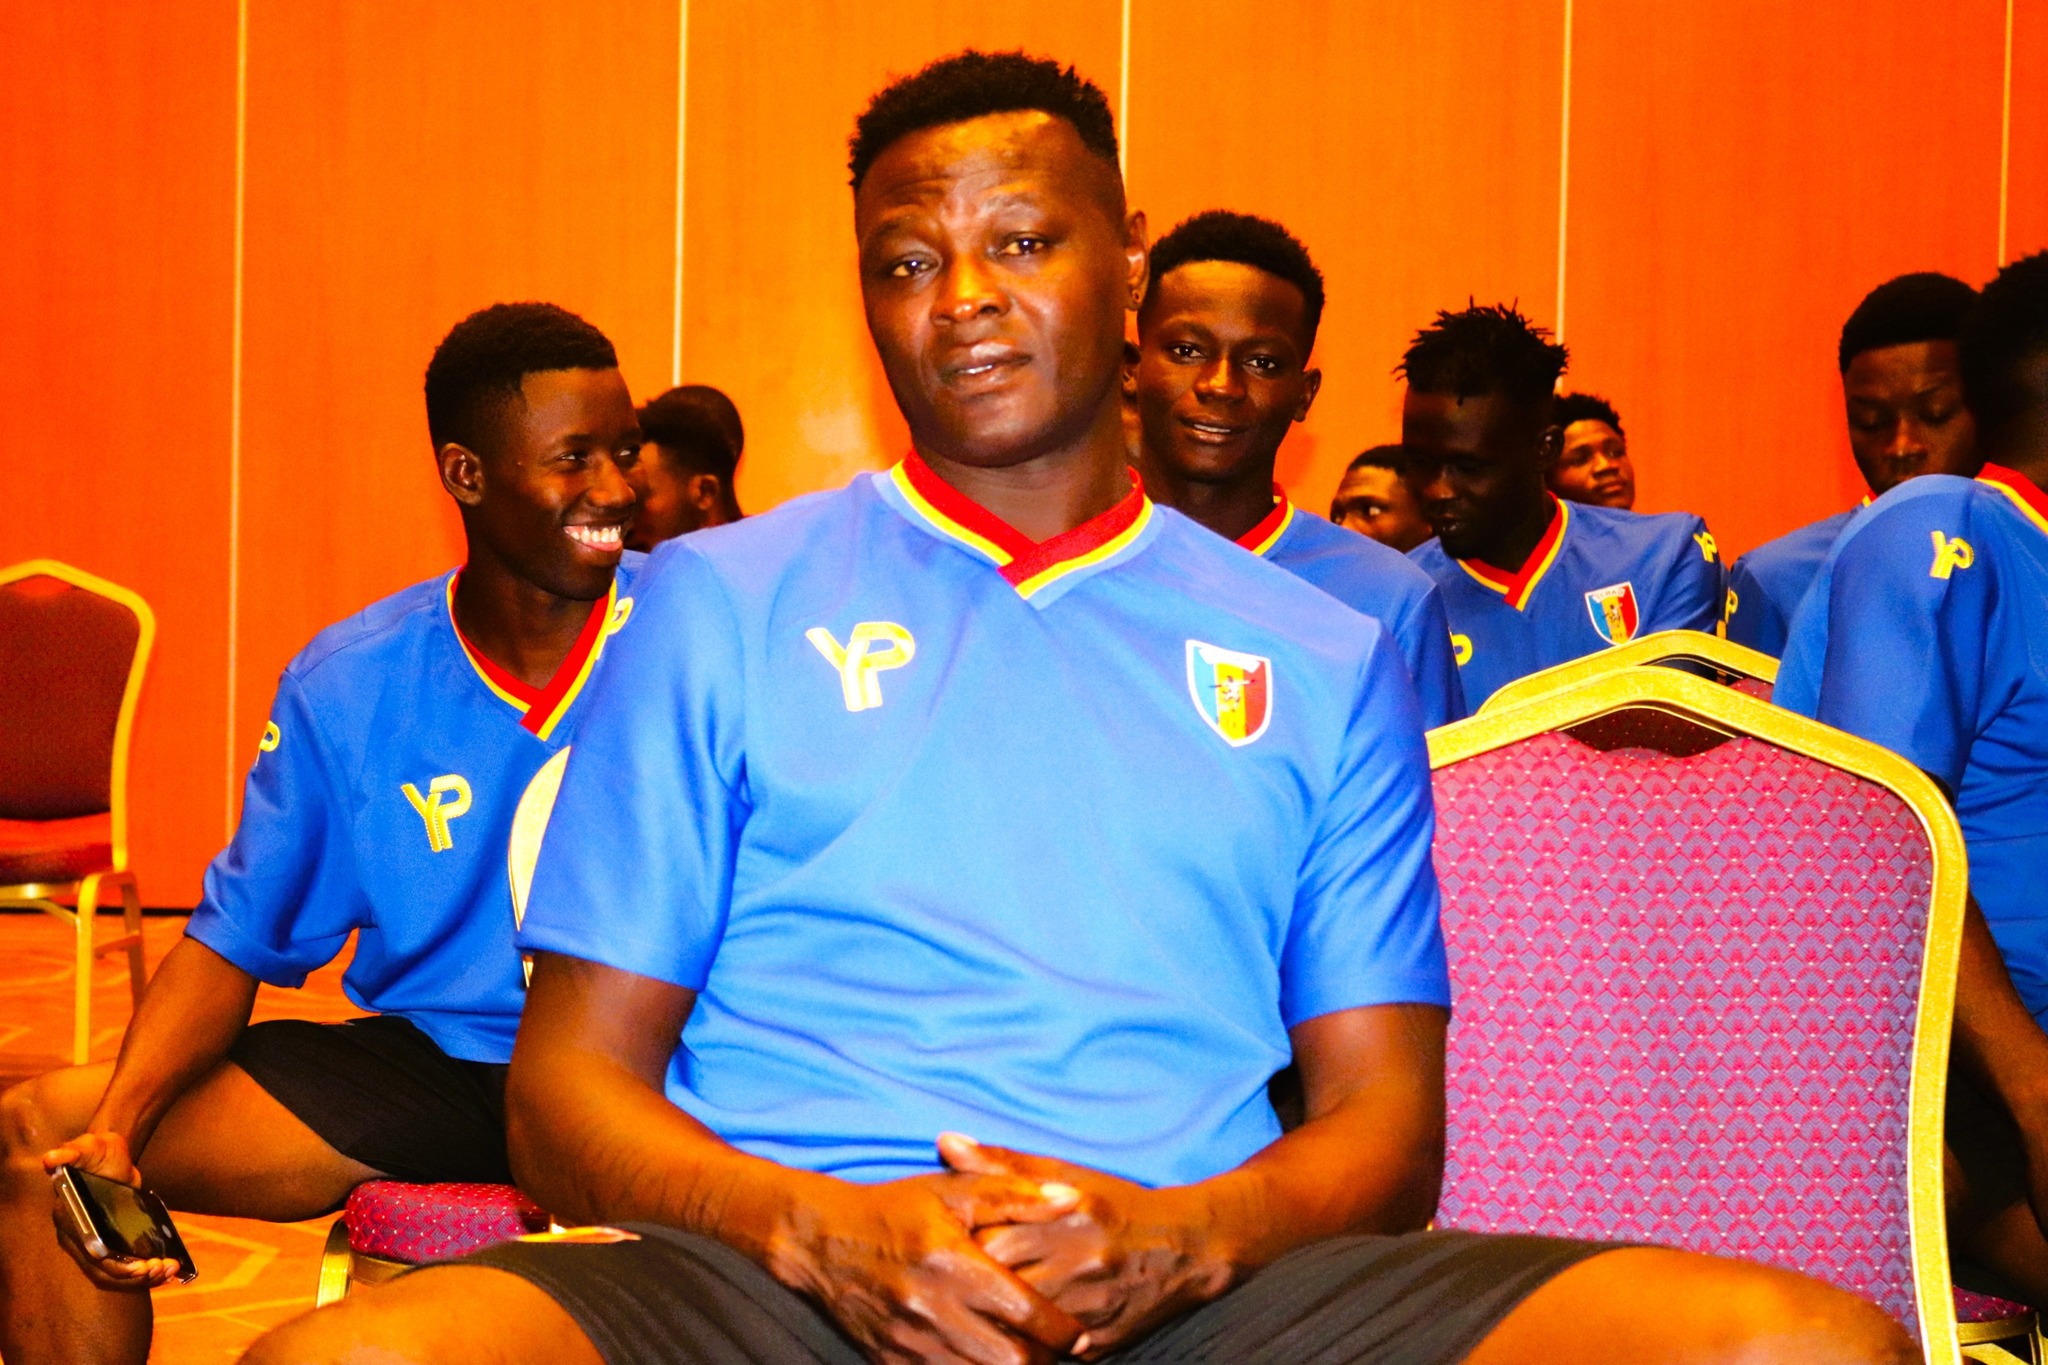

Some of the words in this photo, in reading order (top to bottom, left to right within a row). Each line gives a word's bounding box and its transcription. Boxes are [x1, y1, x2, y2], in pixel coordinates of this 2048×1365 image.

[1693, 531, 1717, 563] YP
[1929, 530, 1974, 579] YP
[805, 621, 915, 711] YP
[400, 774, 473, 853] YP
